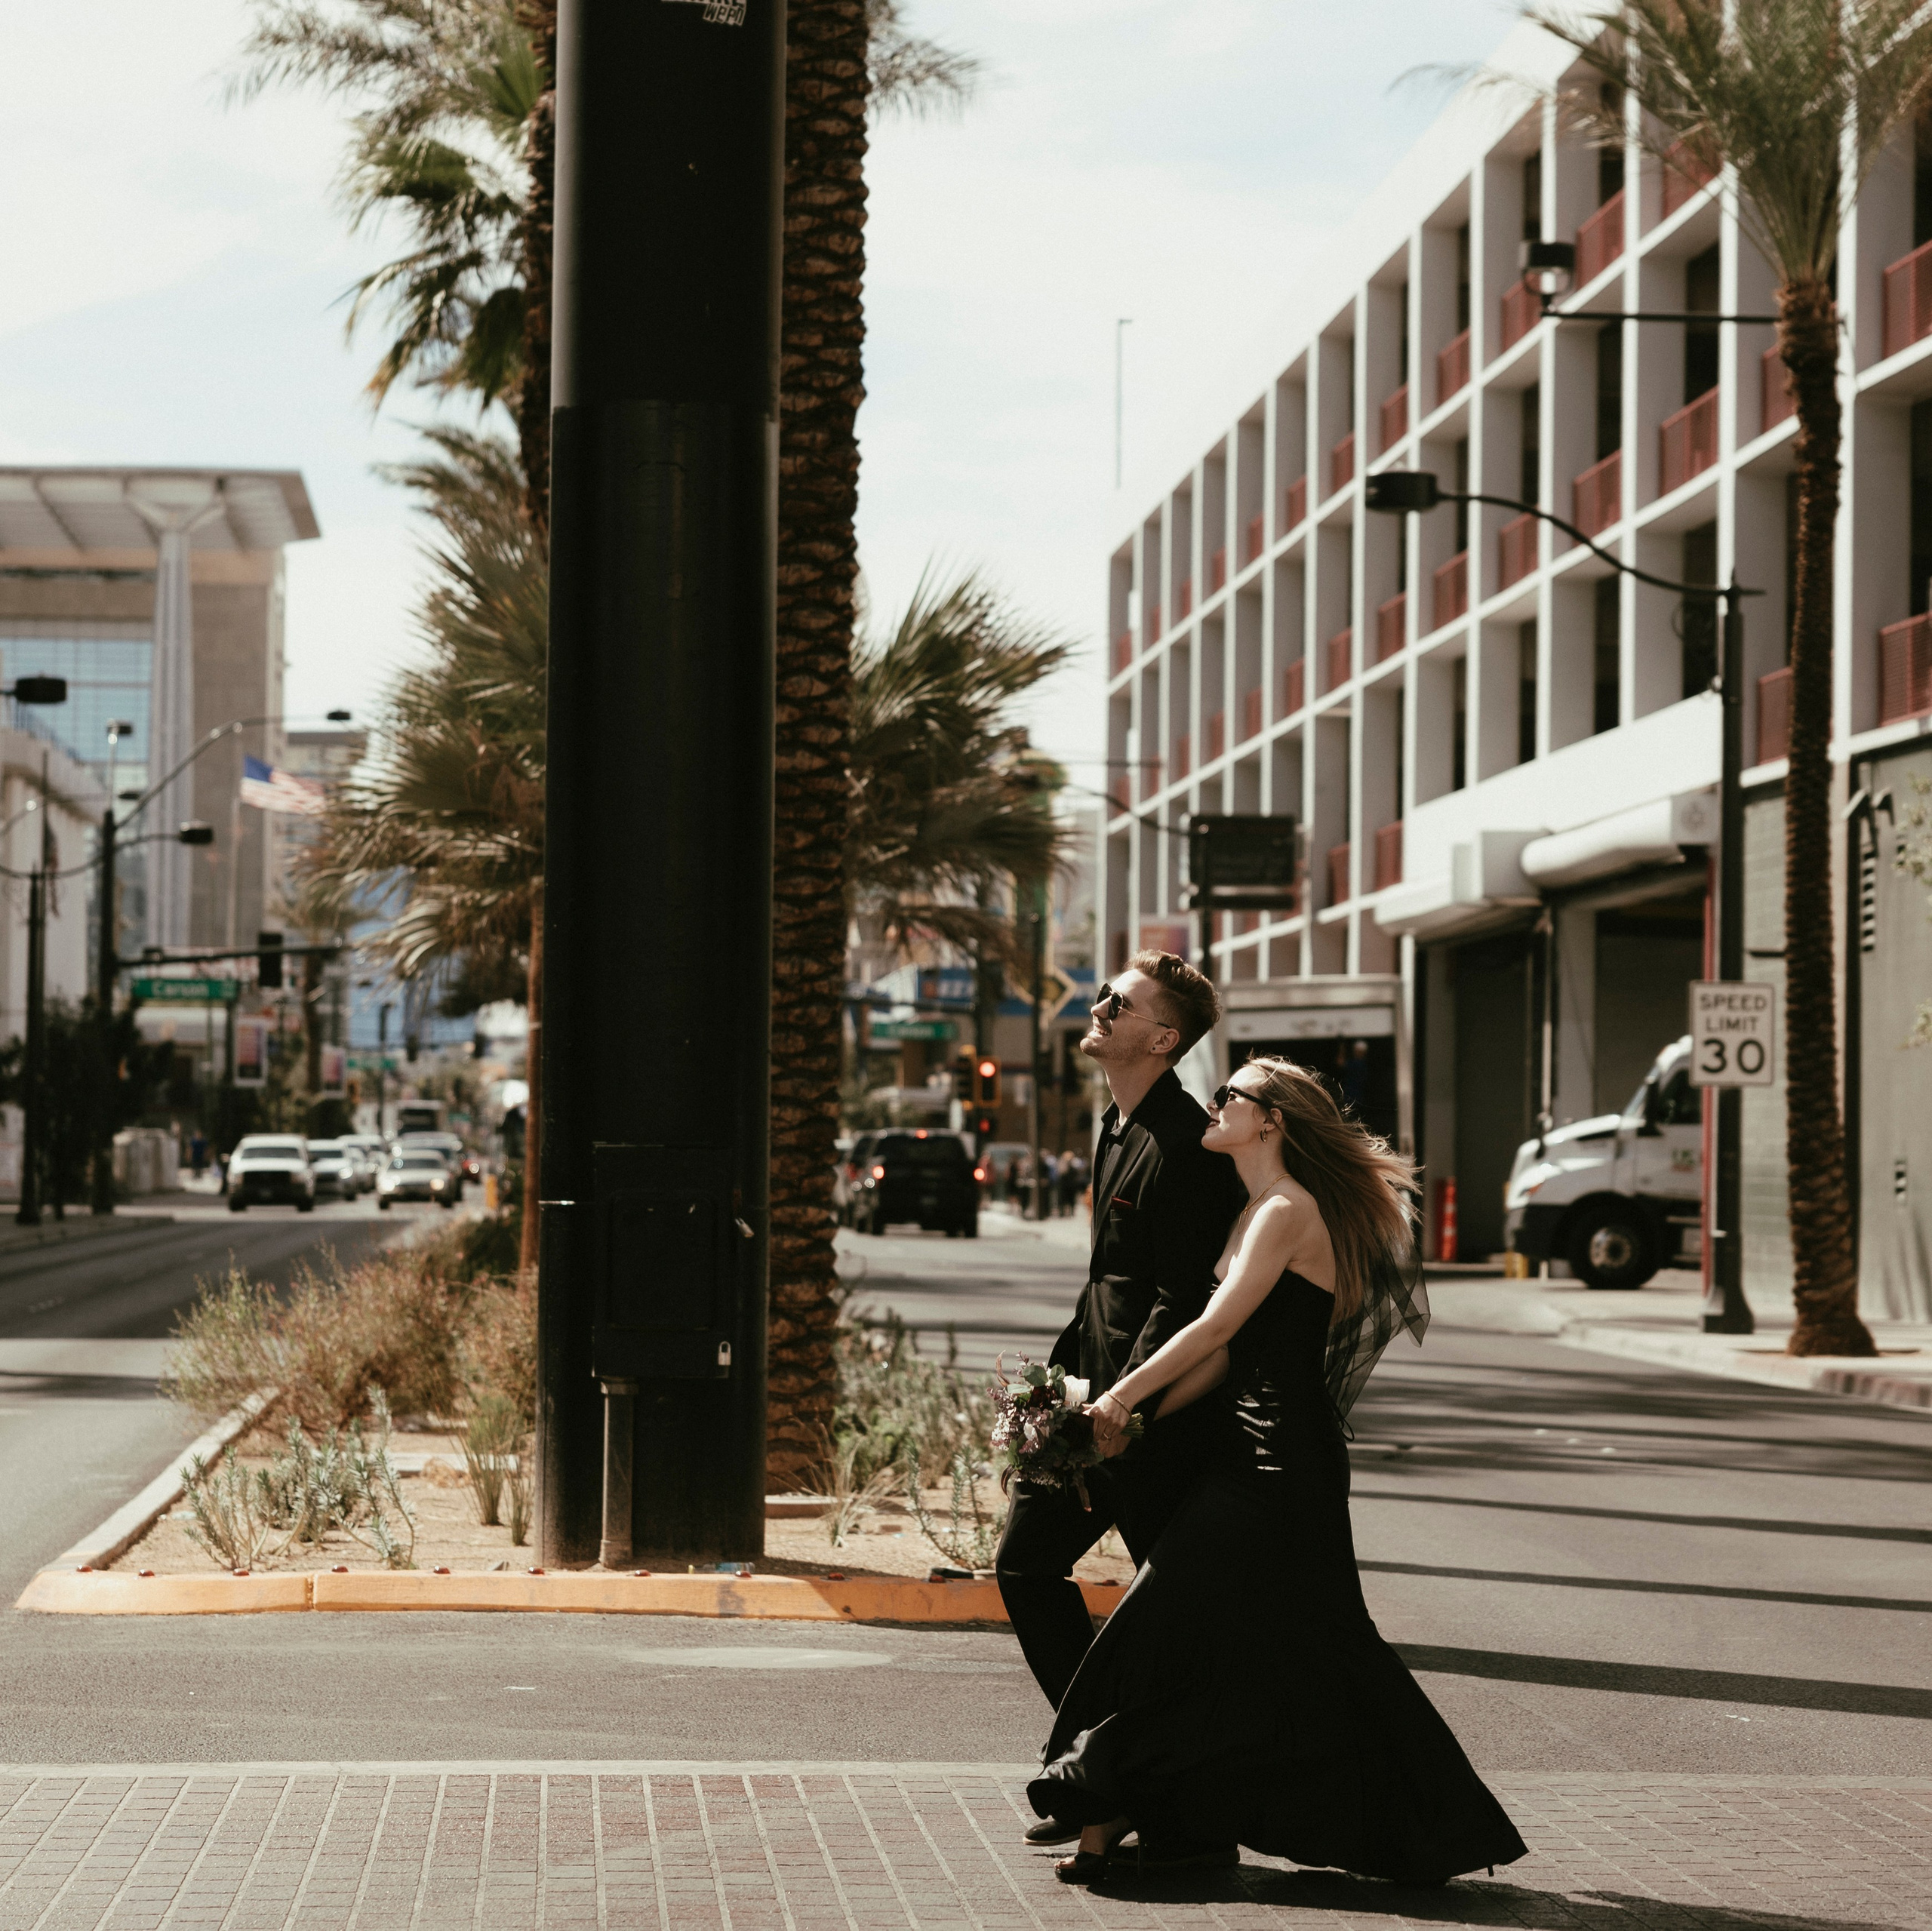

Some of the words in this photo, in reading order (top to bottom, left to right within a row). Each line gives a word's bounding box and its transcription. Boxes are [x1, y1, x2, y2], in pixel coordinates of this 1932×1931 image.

[1700, 994, 1767, 1011] SPEED
[1706, 1016, 1757, 1032] LIMIT
[1701, 1038, 1765, 1074] 30
